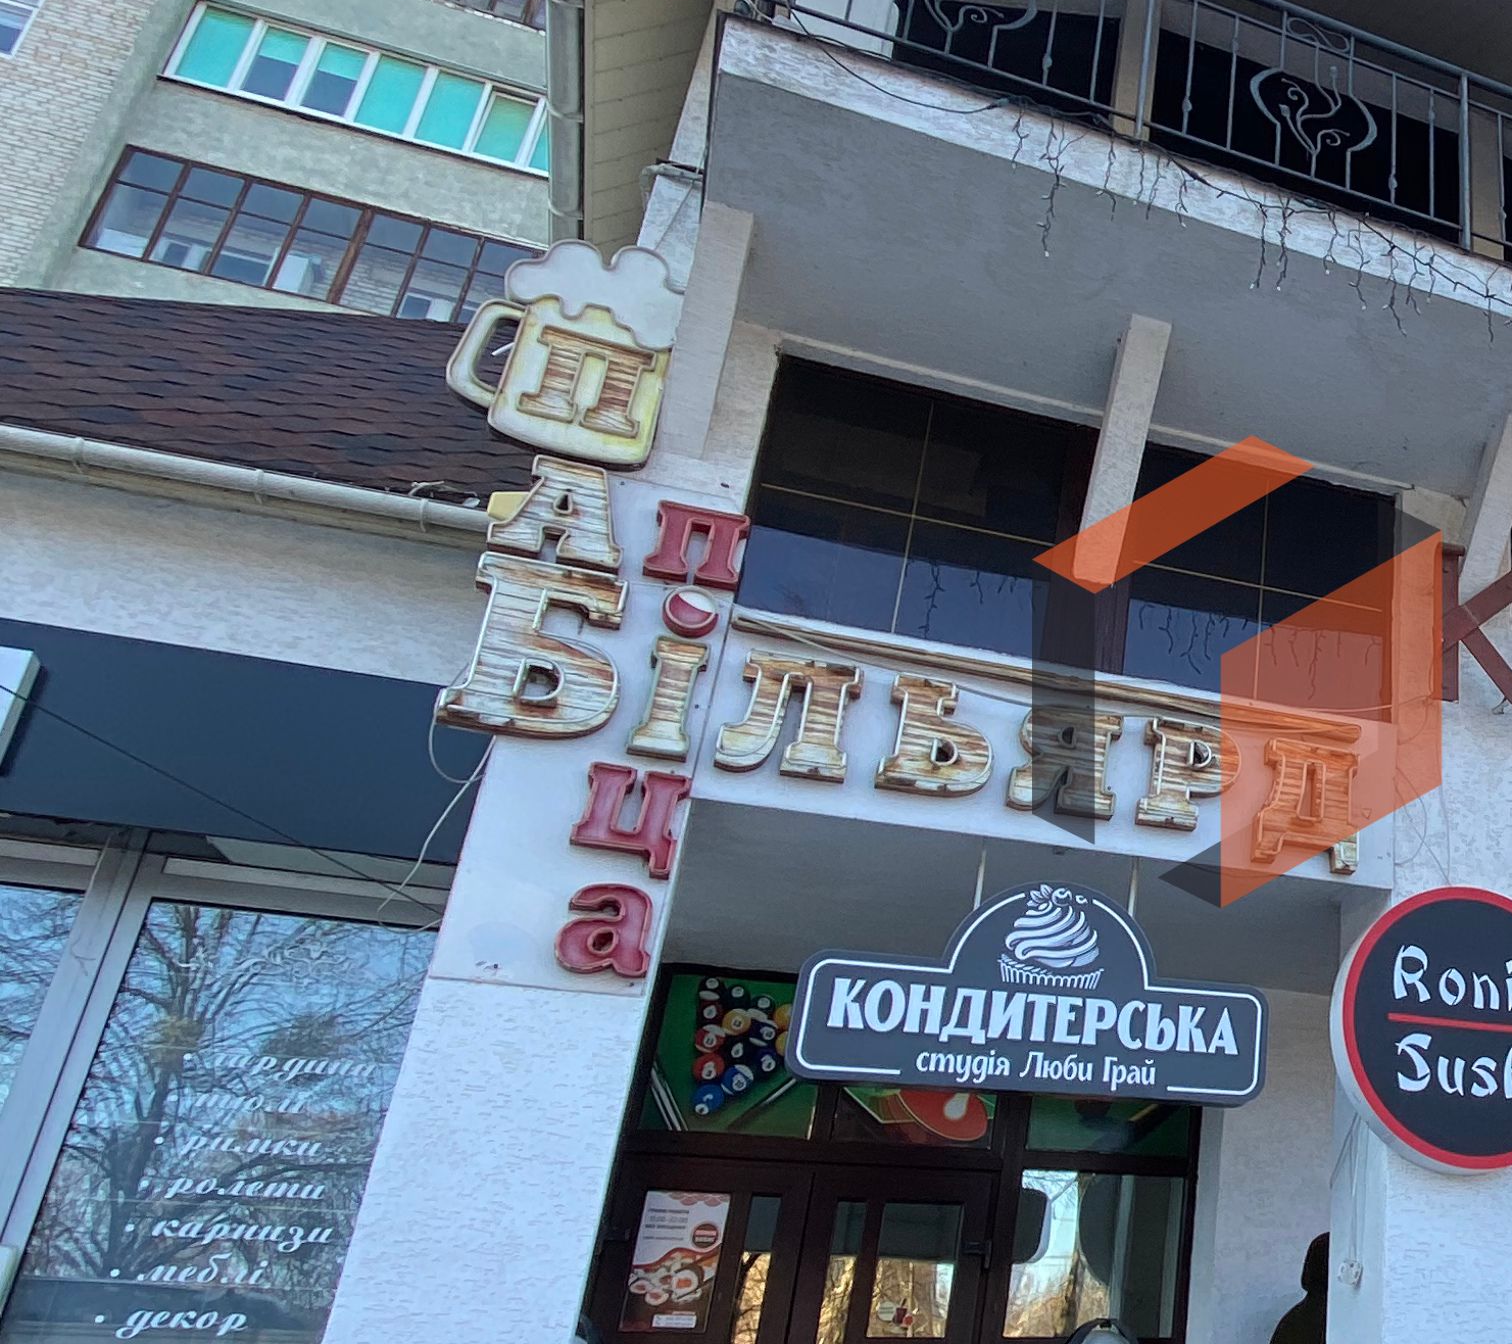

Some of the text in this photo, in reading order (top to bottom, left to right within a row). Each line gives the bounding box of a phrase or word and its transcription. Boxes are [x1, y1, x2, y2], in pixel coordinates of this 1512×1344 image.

[827, 977, 1238, 1055] КОНДИТЕРСЬКА
[916, 1050, 1156, 1091] студія Люби Грай
[164, 1177, 326, 1199] ролети
[115, 1309, 249, 1339] декор
